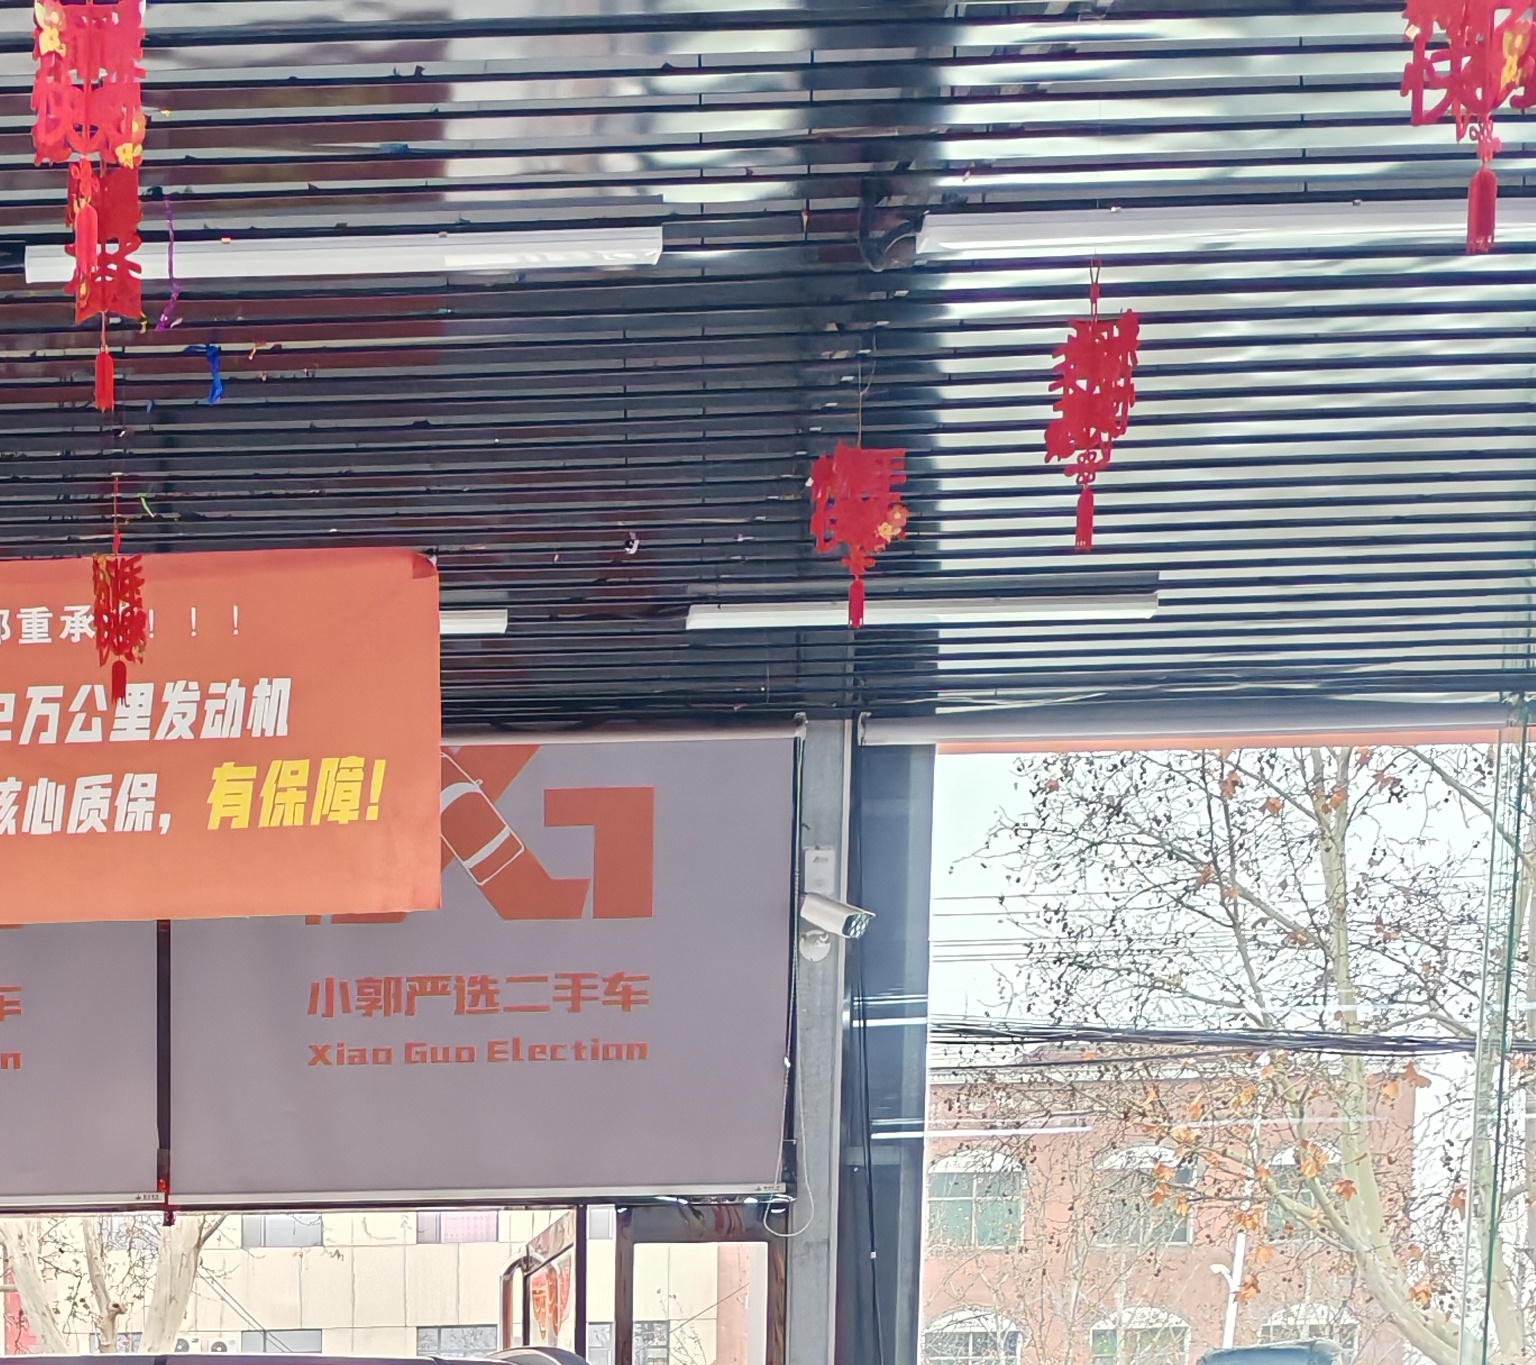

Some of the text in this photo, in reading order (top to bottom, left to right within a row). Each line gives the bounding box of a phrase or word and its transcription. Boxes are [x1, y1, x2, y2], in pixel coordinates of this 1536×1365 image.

[308, 972, 649, 1018] 小郭严选二手车
[308, 1037, 648, 1066] Xiao Guo Election
